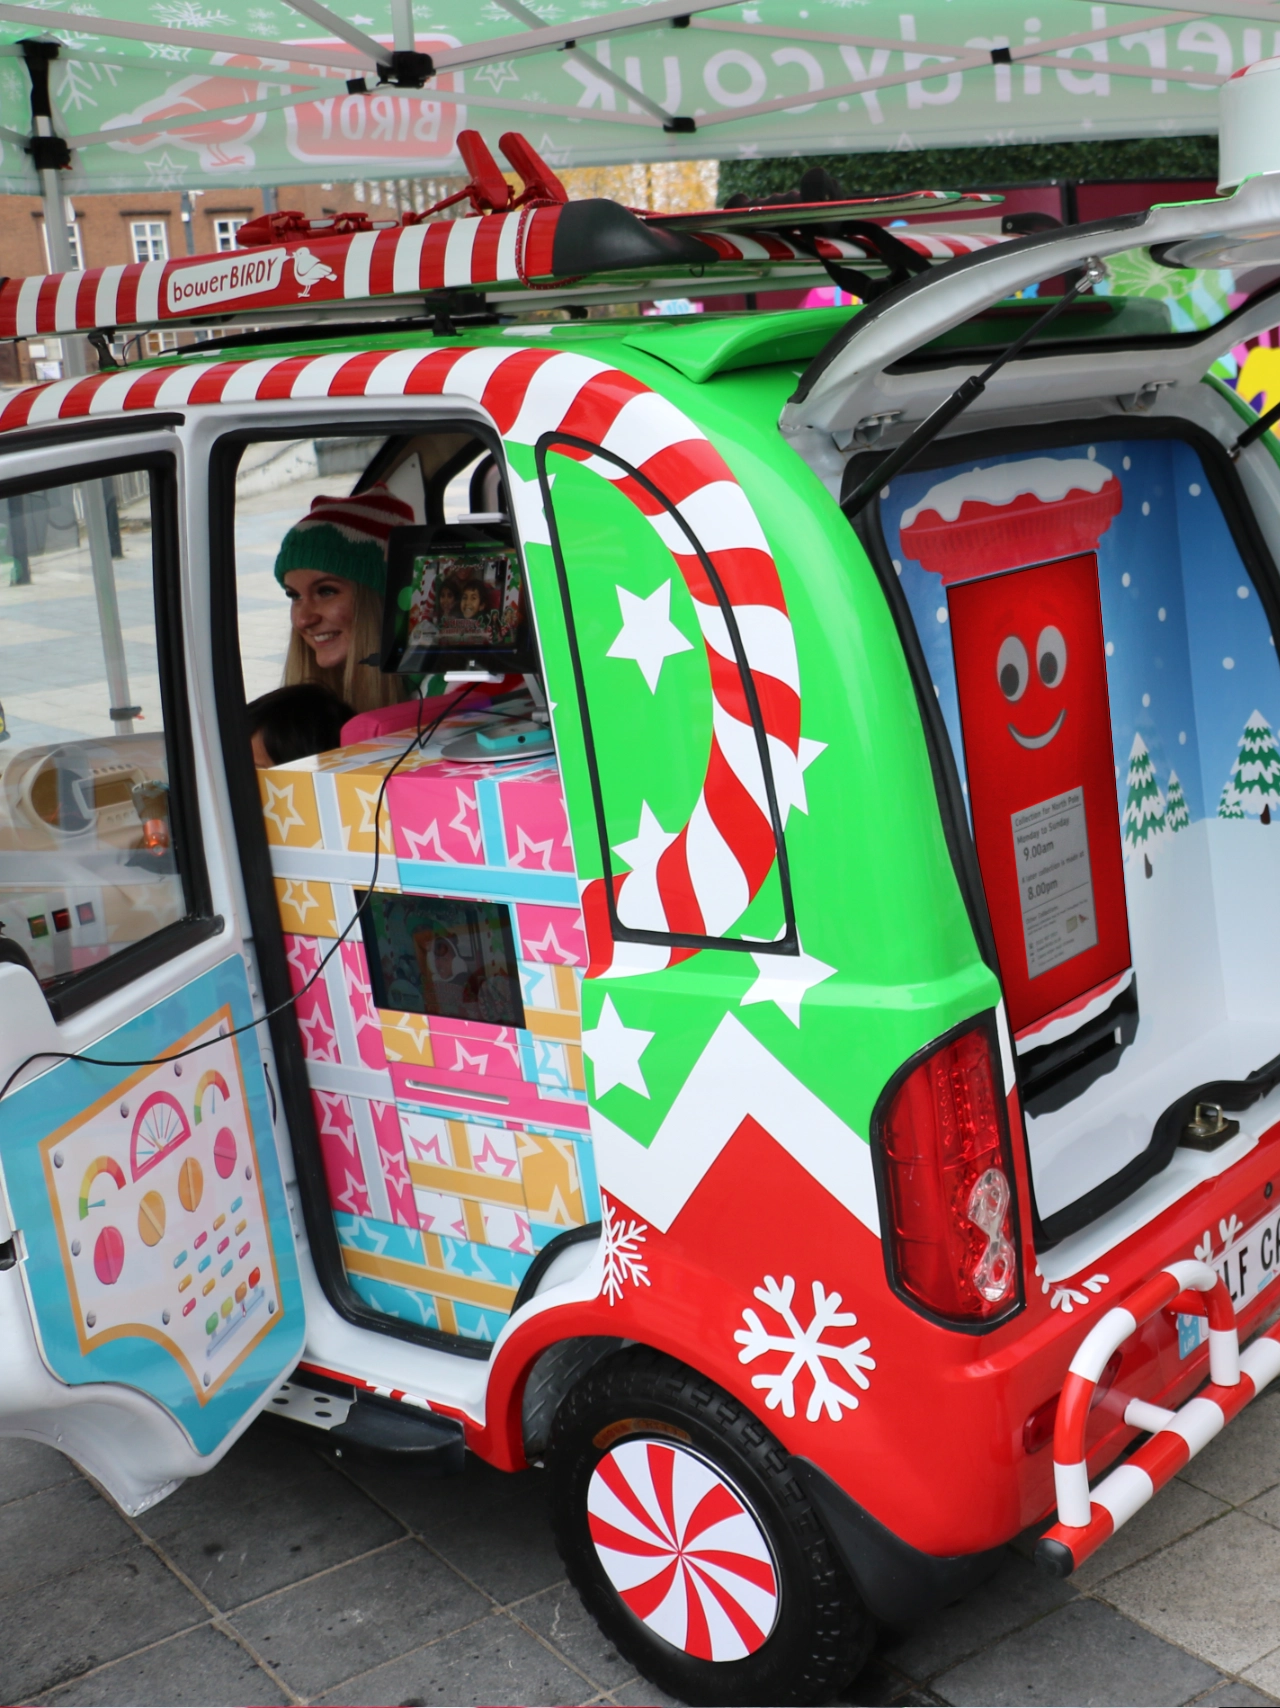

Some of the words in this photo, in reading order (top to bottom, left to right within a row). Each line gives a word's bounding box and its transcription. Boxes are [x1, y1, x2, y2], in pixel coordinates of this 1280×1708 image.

[173, 256, 279, 303] bowerBIRDY
[1015, 811, 1041, 827] Collection
[1042, 807, 1050, 815] for
[1051, 800, 1067, 810] North
[1068, 795, 1079, 804] Pole
[1017, 830, 1040, 845] Monday
[1041, 827, 1047, 835] to
[1048, 817, 1069, 832] Sunday
[1023, 841, 1054, 861] 9.00am
[1038, 862, 1060, 876] collection
[1028, 879, 1058, 900] 8.00pm
[1216, 1245, 1249, 1304] LF
